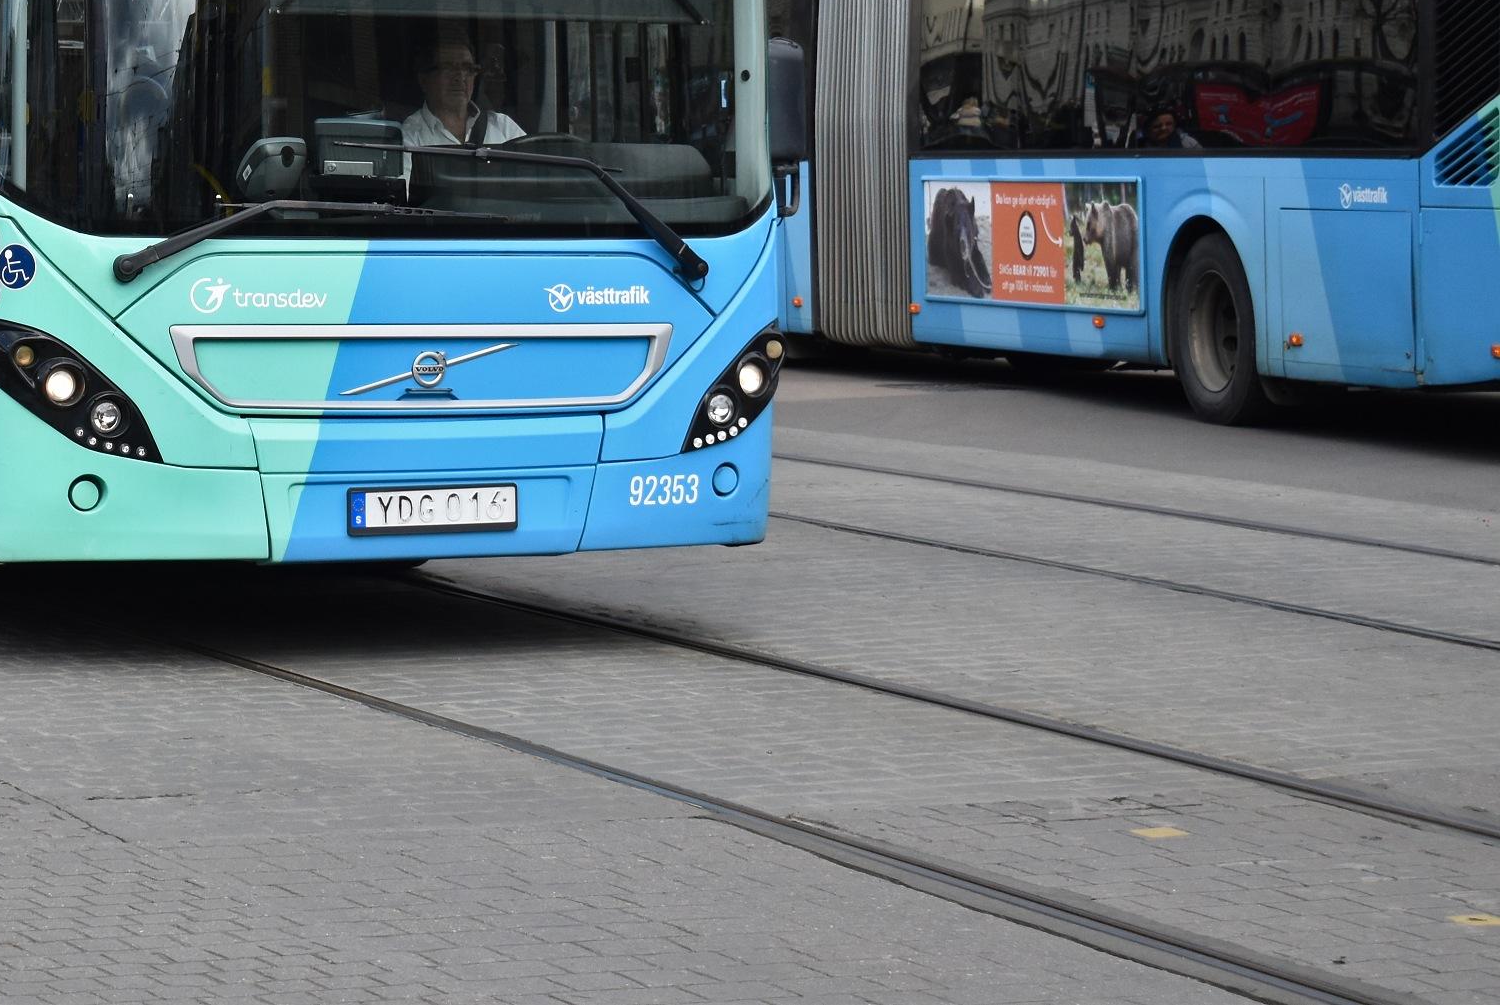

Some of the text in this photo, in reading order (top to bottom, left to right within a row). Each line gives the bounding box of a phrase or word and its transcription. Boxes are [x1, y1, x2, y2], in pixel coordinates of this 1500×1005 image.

[1352, 186, 1388, 204] västtrafik
[233, 288, 327, 308] transdev
[577, 286, 650, 305] västtrafik
[629, 474, 699, 506] 92353
[355, 515, 362, 524] S
[377, 494, 434, 524] YDG
